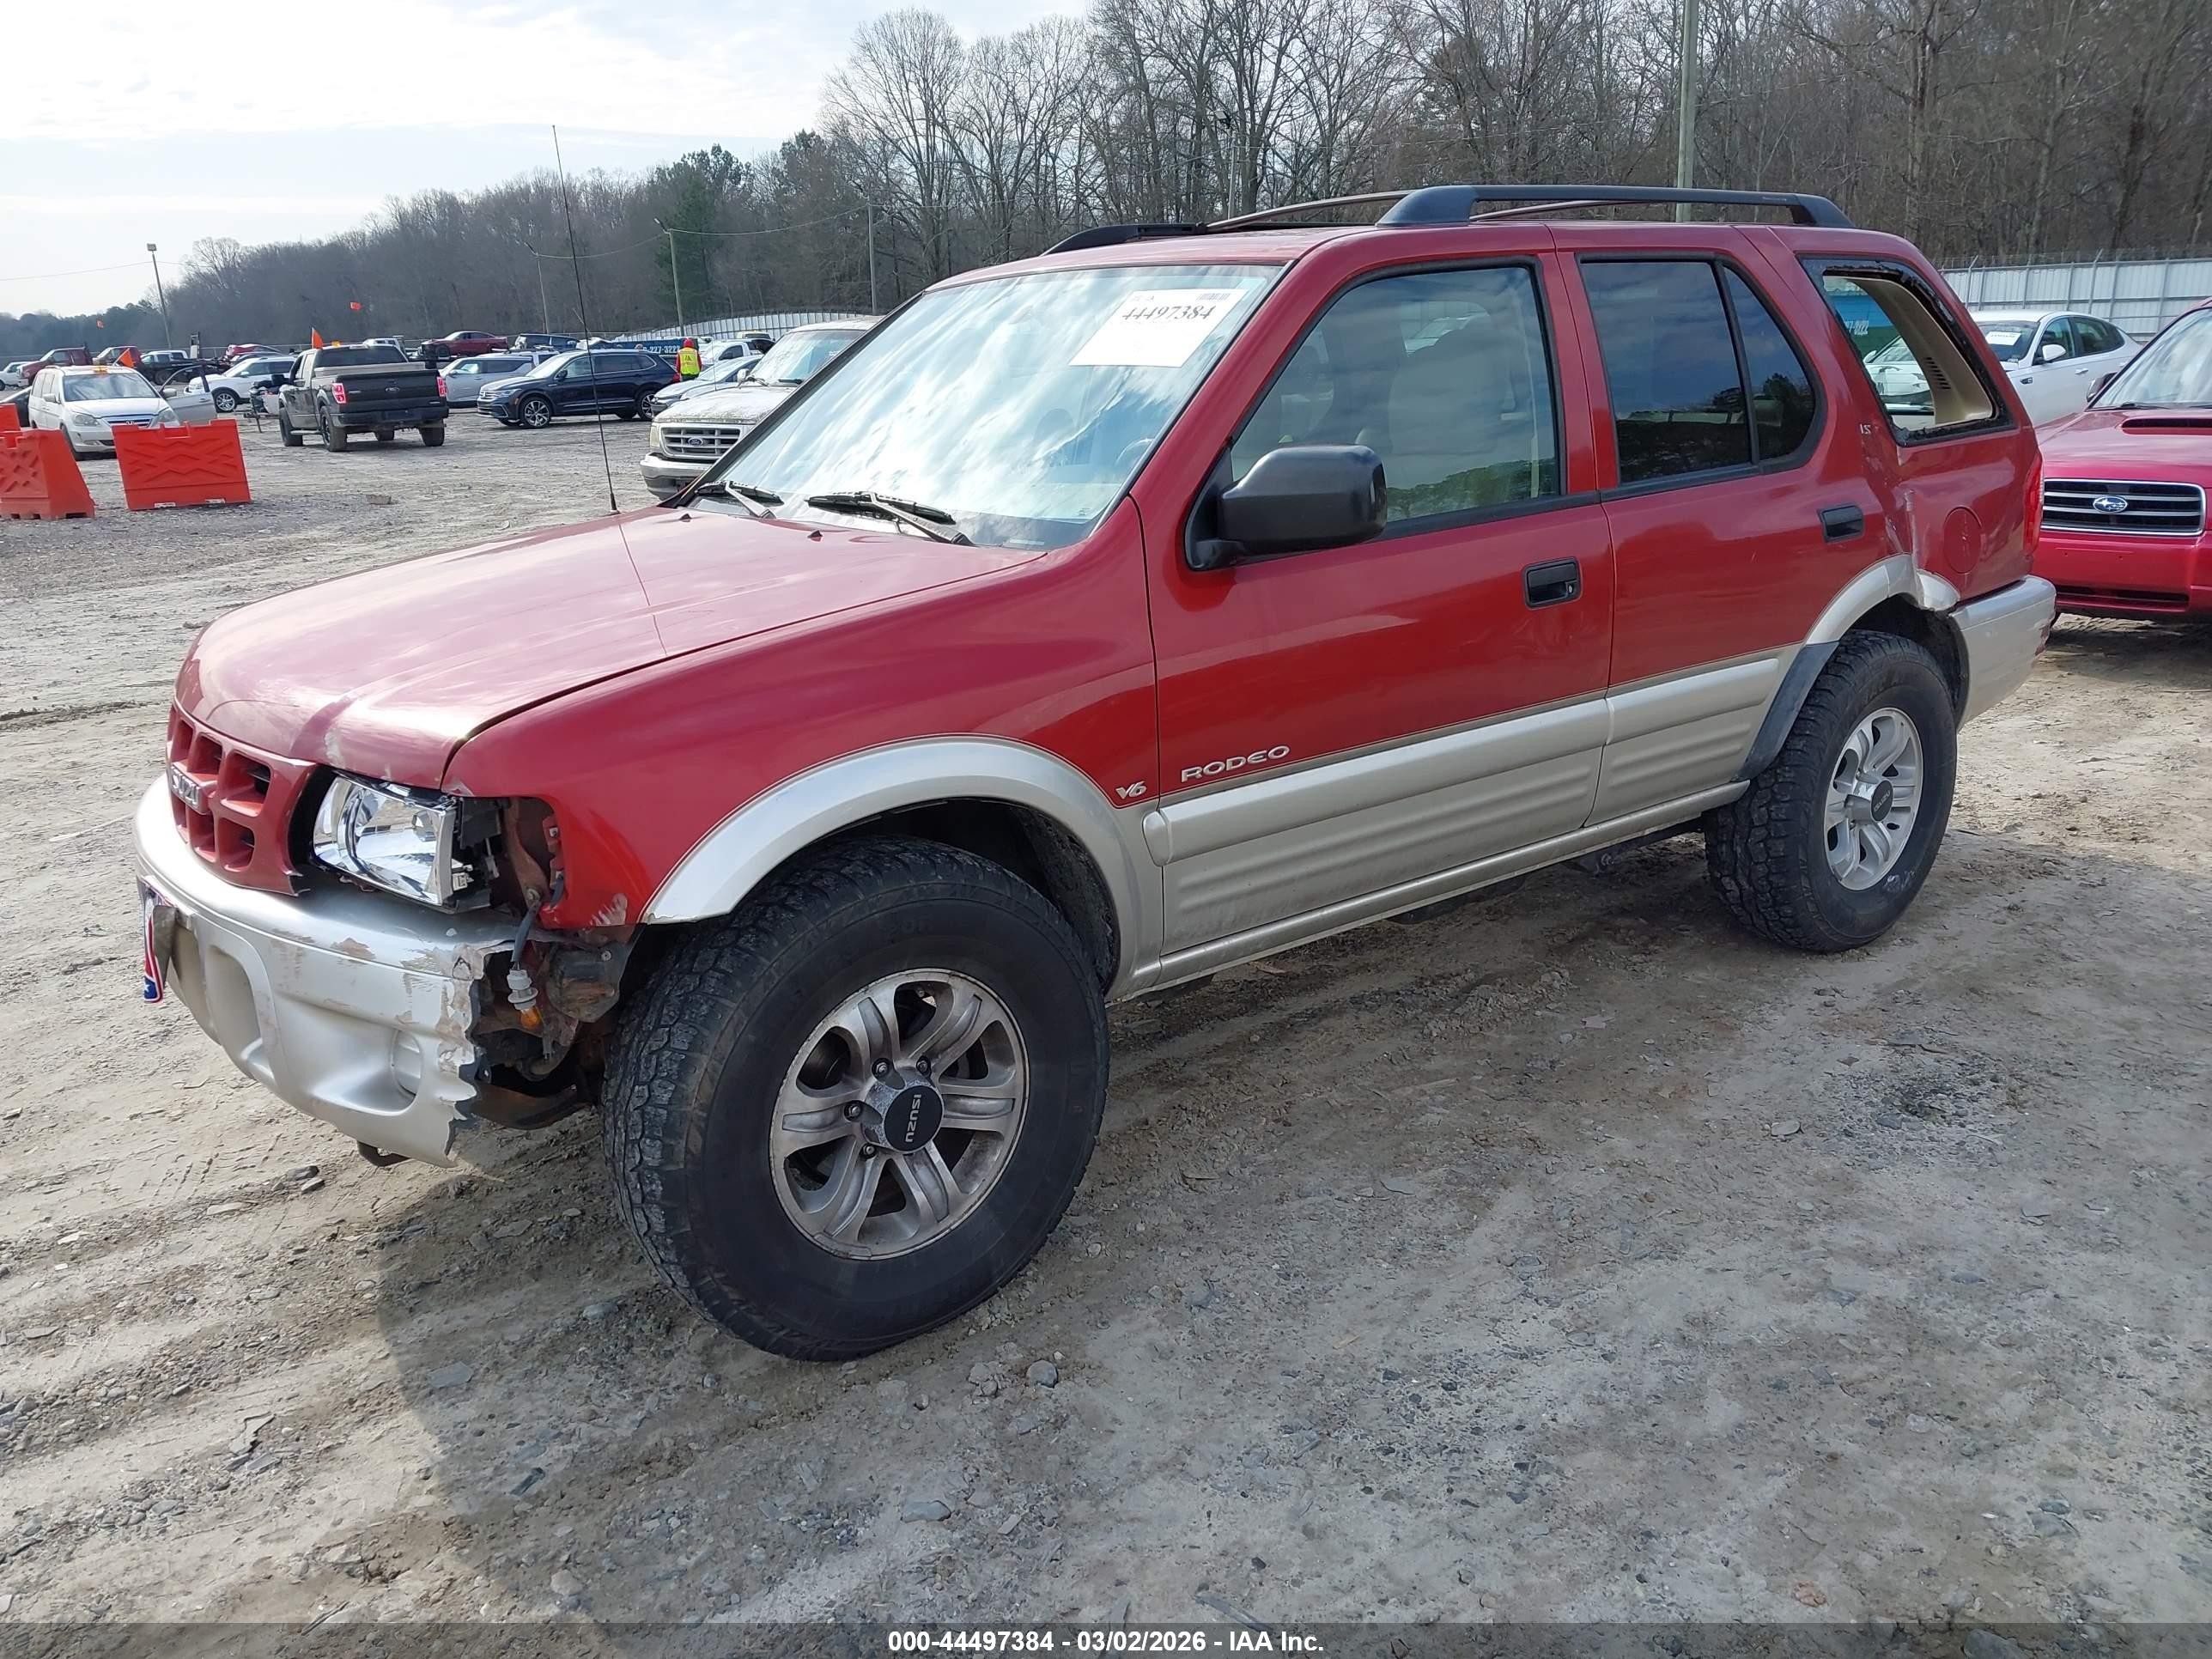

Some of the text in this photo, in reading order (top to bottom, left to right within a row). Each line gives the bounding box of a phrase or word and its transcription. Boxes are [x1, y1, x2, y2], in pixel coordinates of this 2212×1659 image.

[1121, 305, 1216, 319] 44497384
[1181, 745, 1291, 782] RODEO
[1115, 781, 1148, 799] V6
[1874, 790, 1891, 812] ISUZU
[904, 1094, 922, 1142] ISUZU
